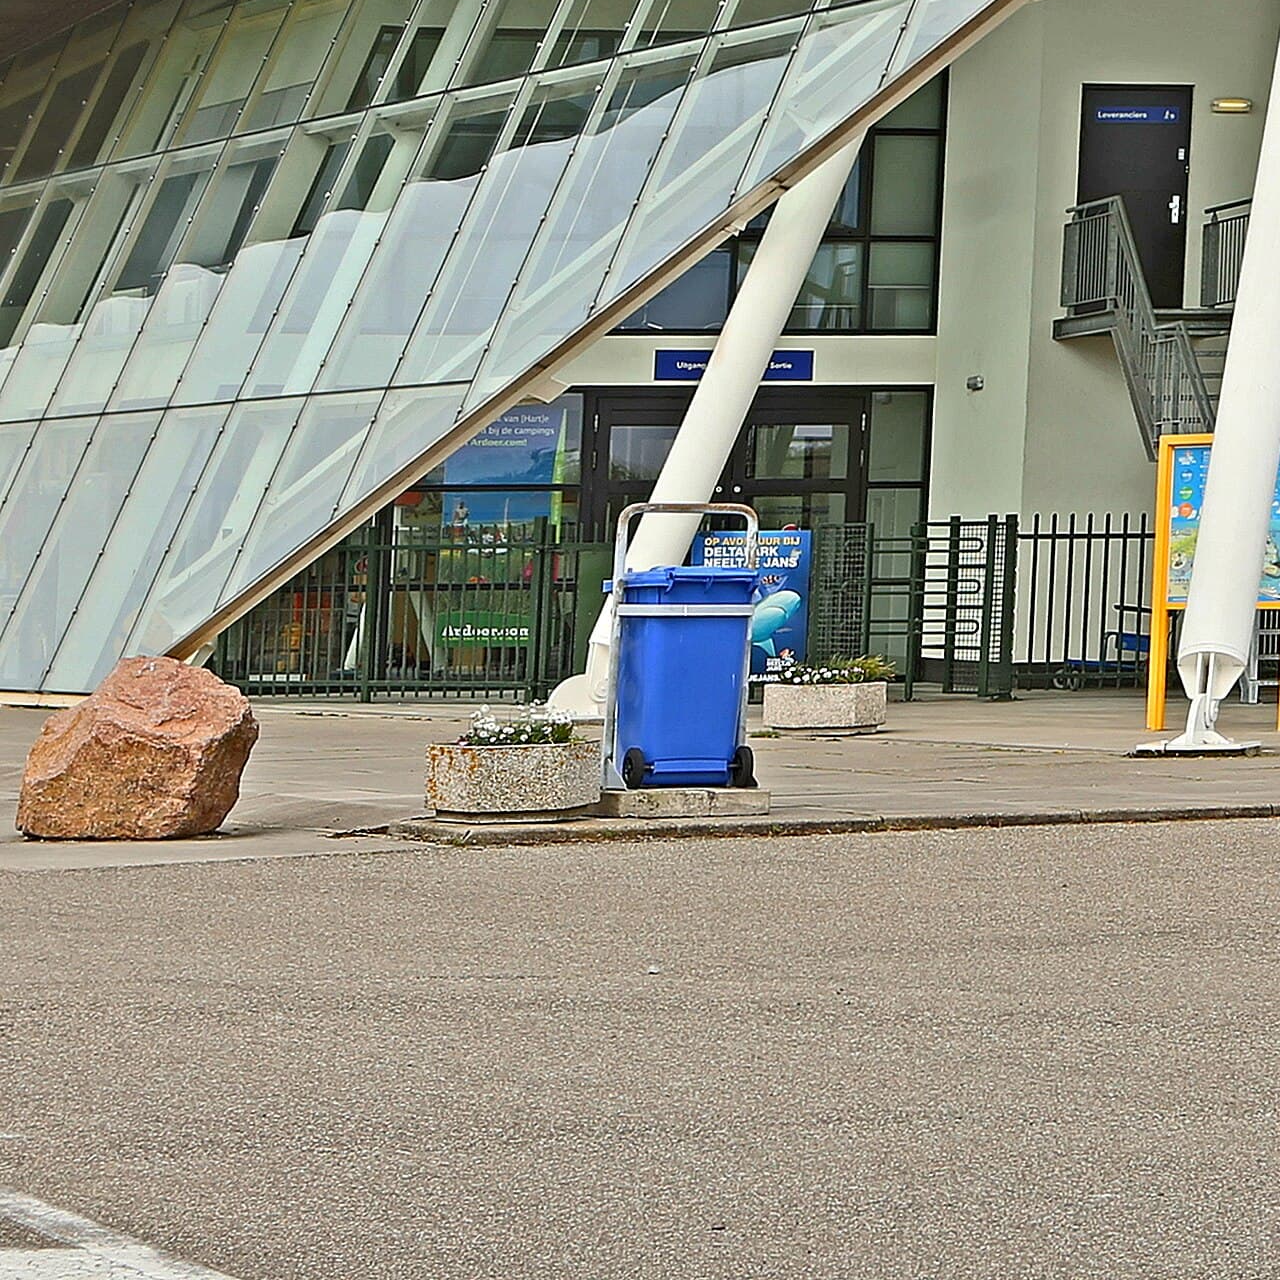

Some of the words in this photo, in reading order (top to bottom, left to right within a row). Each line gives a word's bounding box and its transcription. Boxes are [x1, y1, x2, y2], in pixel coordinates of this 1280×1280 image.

[501, 426, 512, 435] de
[514, 427, 555, 436] campings
[704, 537, 720, 546] OP
[783, 535, 801, 545] BIJ
[763, 556, 797, 568] JANS
